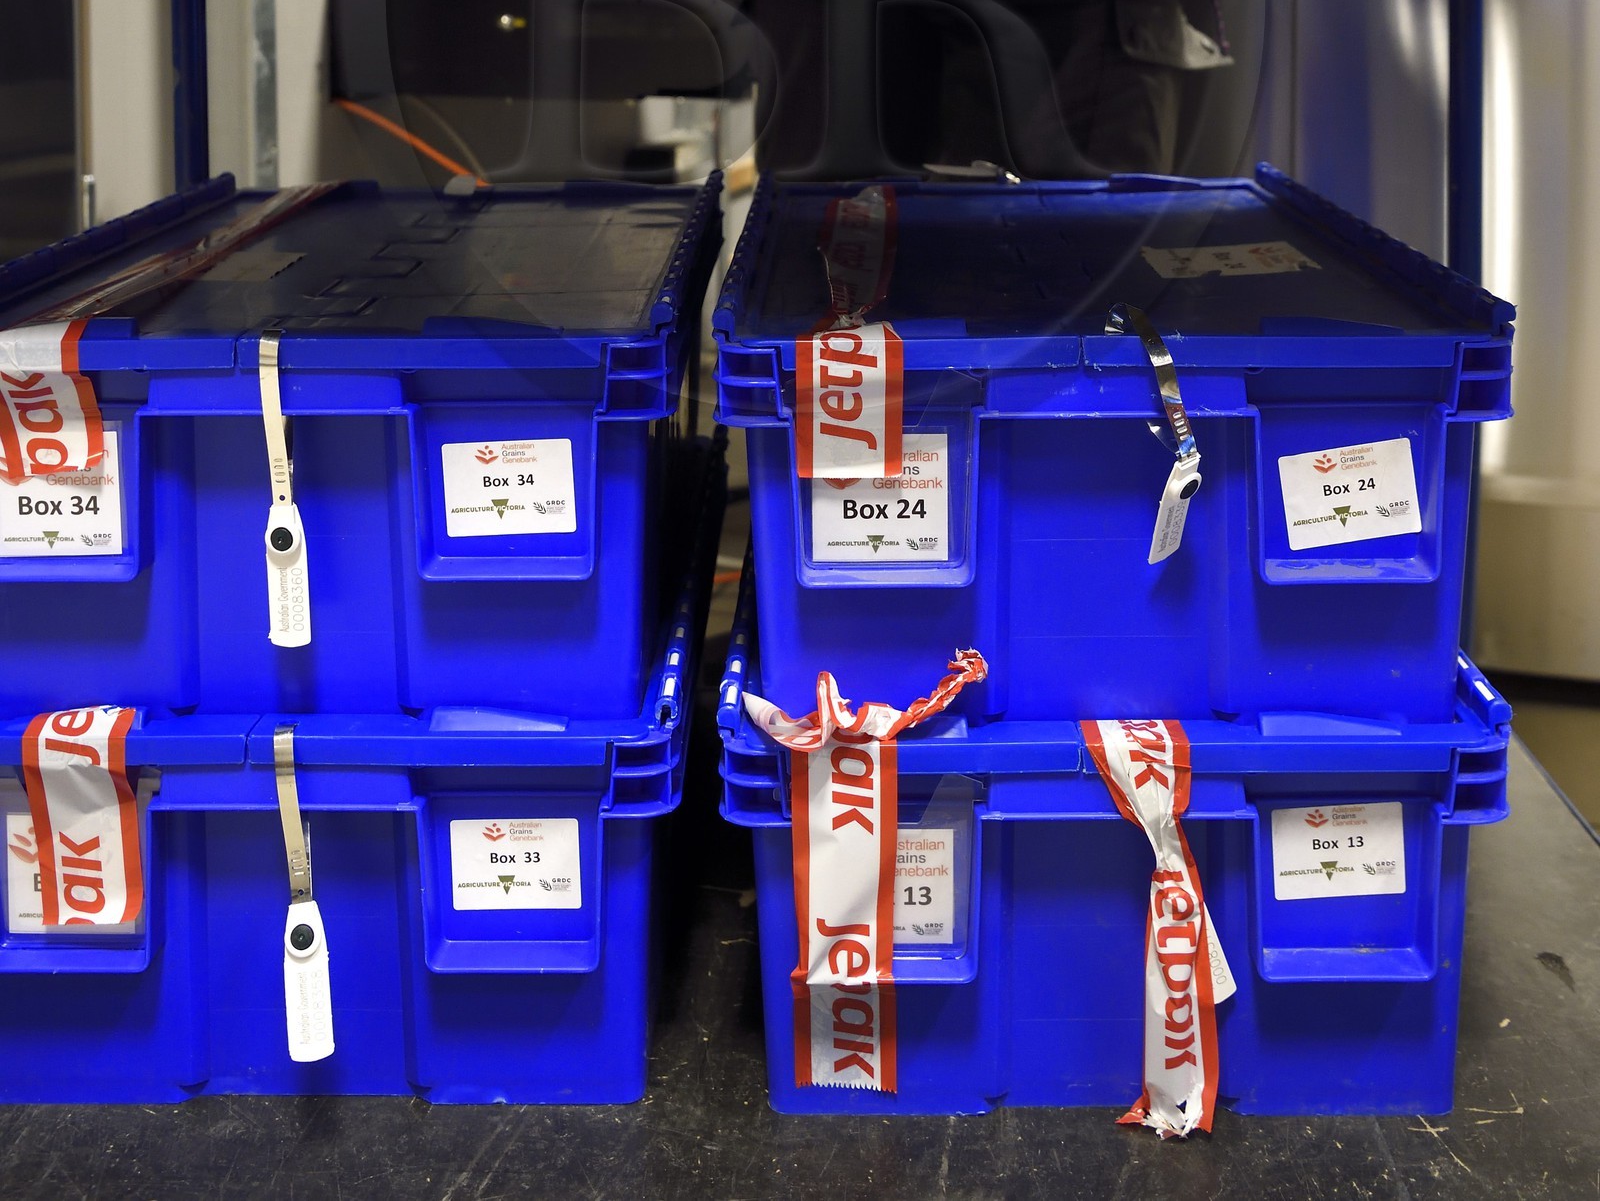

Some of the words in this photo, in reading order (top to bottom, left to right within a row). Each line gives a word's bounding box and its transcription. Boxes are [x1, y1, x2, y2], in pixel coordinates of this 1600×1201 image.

[820, 325, 877, 450] Jetp
[902, 450, 939, 463] ralian
[1340, 446, 1374, 456] Australian
[502, 456, 537, 464] Genebank
[1340, 454, 1365, 464] Grains
[1341, 460, 1378, 471] Genebank
[46, 474, 114, 486] Genebank
[483, 476, 509, 488] Box
[517, 474, 534, 486] 34
[872, 477, 943, 489] Genebank
[1323, 484, 1350, 496] Box
[1358, 478, 1376, 491] 24
[18, 496, 63, 515] Box
[70, 495, 99, 515] 34
[451, 506, 494, 514] AGRICULTURE
[843, 499, 888, 519] Box
[896, 499, 926, 519] 24
[1388, 500, 1410, 508] GRDC
[1293, 515, 1336, 526] AGRICULTURE
[291, 567, 304, 632] 0008360
[897, 839, 945, 850] stralian
[1312, 839, 1339, 850] Box
[1347, 836, 1364, 848] 13
[490, 853, 516, 864] Box
[524, 852, 541, 863] 33
[897, 852, 926, 864] ains
[895, 865, 949, 876] enebank
[1280, 867, 1323, 876] AGRICULTURE
[903, 886, 932, 906] 13
